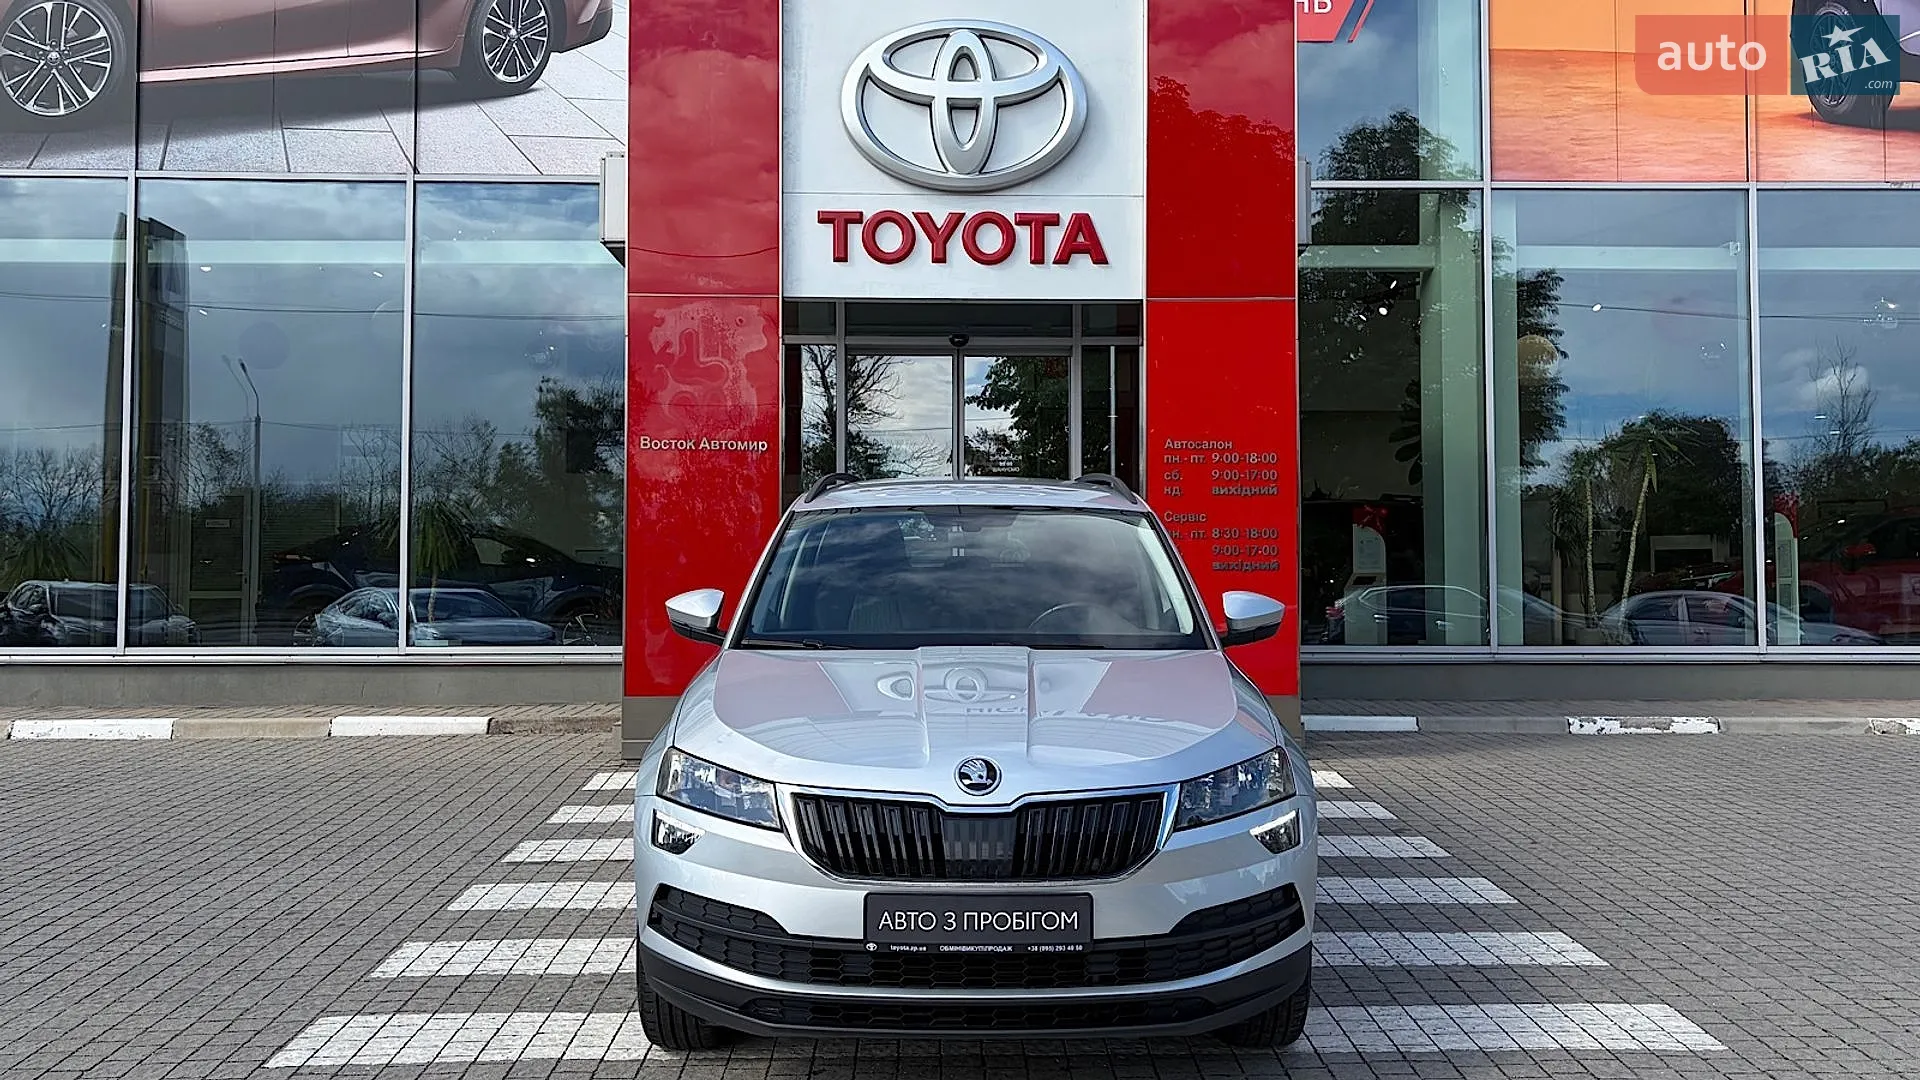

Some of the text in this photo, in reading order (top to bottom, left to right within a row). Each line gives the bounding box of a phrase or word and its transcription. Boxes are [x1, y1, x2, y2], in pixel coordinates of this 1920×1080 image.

[817, 209, 1109, 266] TOYOTA
[640, 436, 768, 453] Восток Автомир
[1164, 439, 1232, 449] Автосалон
[1211, 453, 1277, 464] 9:00-18:00
[1164, 470, 1278, 480] сб. 9:00-17:00
[1212, 484, 1278, 496] вихідний
[1164, 511, 1207, 523] Сервіс
[1212, 560, 1279, 571] вихідний
[878, 911, 936, 930] АВТО
[963, 911, 1078, 930] ПРОБІГОМ
